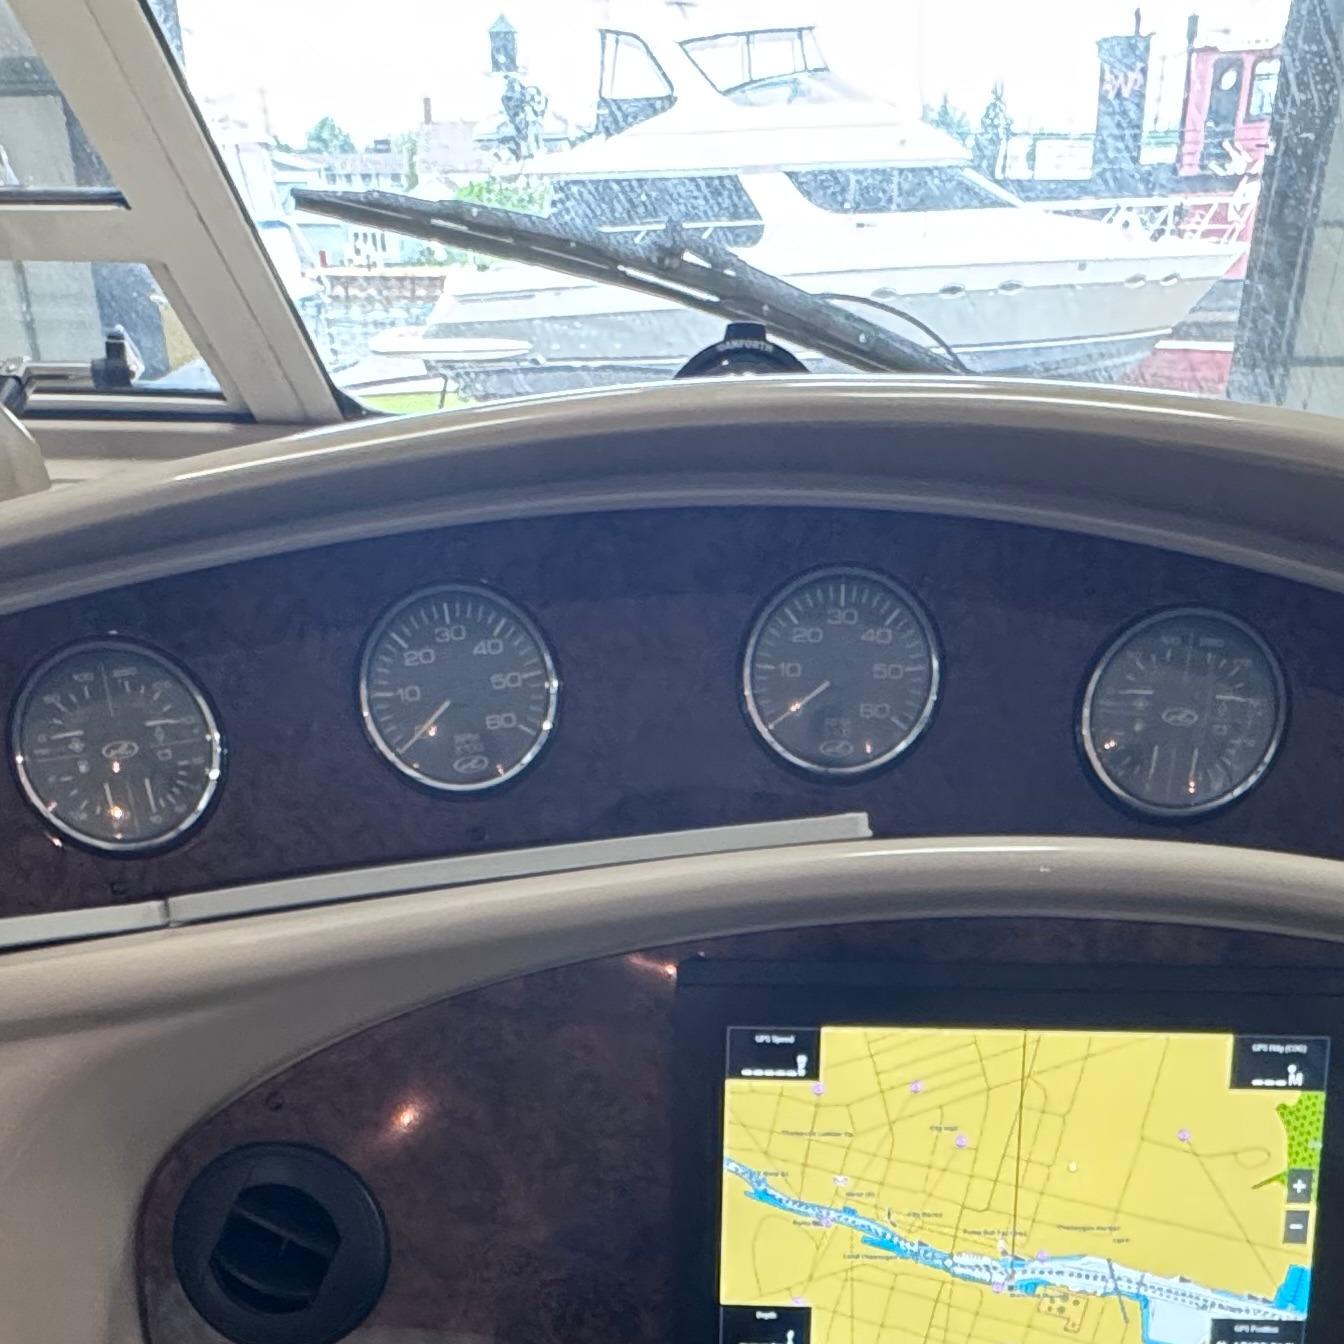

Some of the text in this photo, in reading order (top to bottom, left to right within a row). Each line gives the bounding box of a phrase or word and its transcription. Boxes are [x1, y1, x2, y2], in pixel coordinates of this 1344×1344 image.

[826, 608, 858, 625] 30
[434, 624, 466, 643] 30
[791, 627, 823, 643] 20
[860, 627, 892, 644] 40
[472, 638, 504, 656] 40
[402, 648, 435, 666] 20
[778, 662, 802, 678] 10
[872, 662, 904, 680] 50
[489, 672, 522, 690] 50
[395, 685, 420, 702] 10
[859, 702, 890, 719] 60
[485, 712, 517, 730] 60
